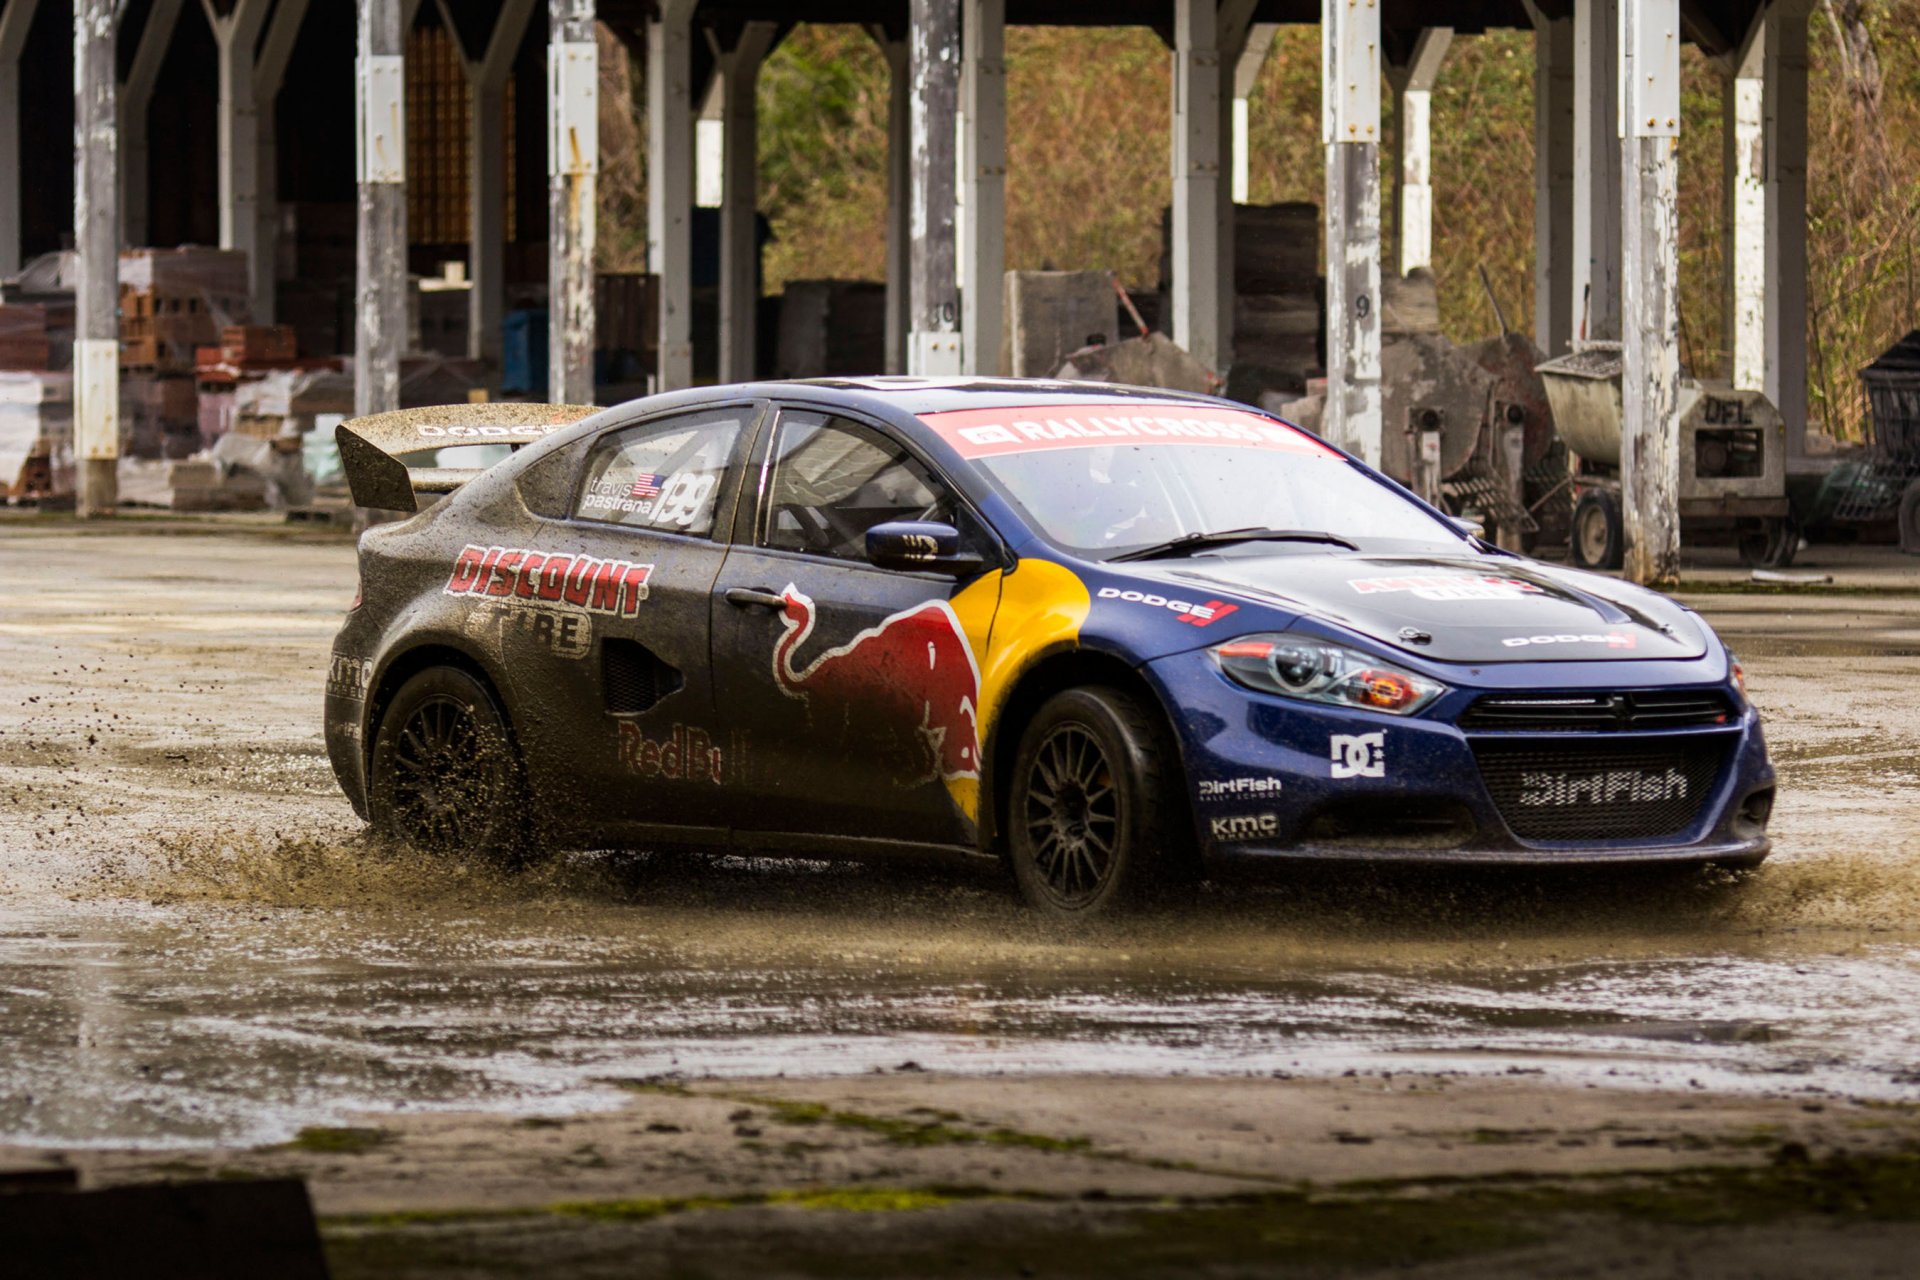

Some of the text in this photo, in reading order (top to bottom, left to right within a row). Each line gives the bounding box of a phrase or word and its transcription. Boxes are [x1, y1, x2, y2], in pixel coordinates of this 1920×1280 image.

[1355, 294, 1370, 319] 9
[1013, 416, 1263, 442] RALLYCROSS
[590, 477, 633, 497] travis
[648, 472, 715, 526] 199
[582, 493, 652, 515] pastrana
[444, 545, 654, 618] DISCOUNT
[1097, 587, 1216, 619] DODGE
[618, 720, 684, 779] Red
[1331, 732, 1385, 778] DC
[1199, 776, 1282, 794] DirtFish
[1519, 768, 1688, 806] DirtFish
